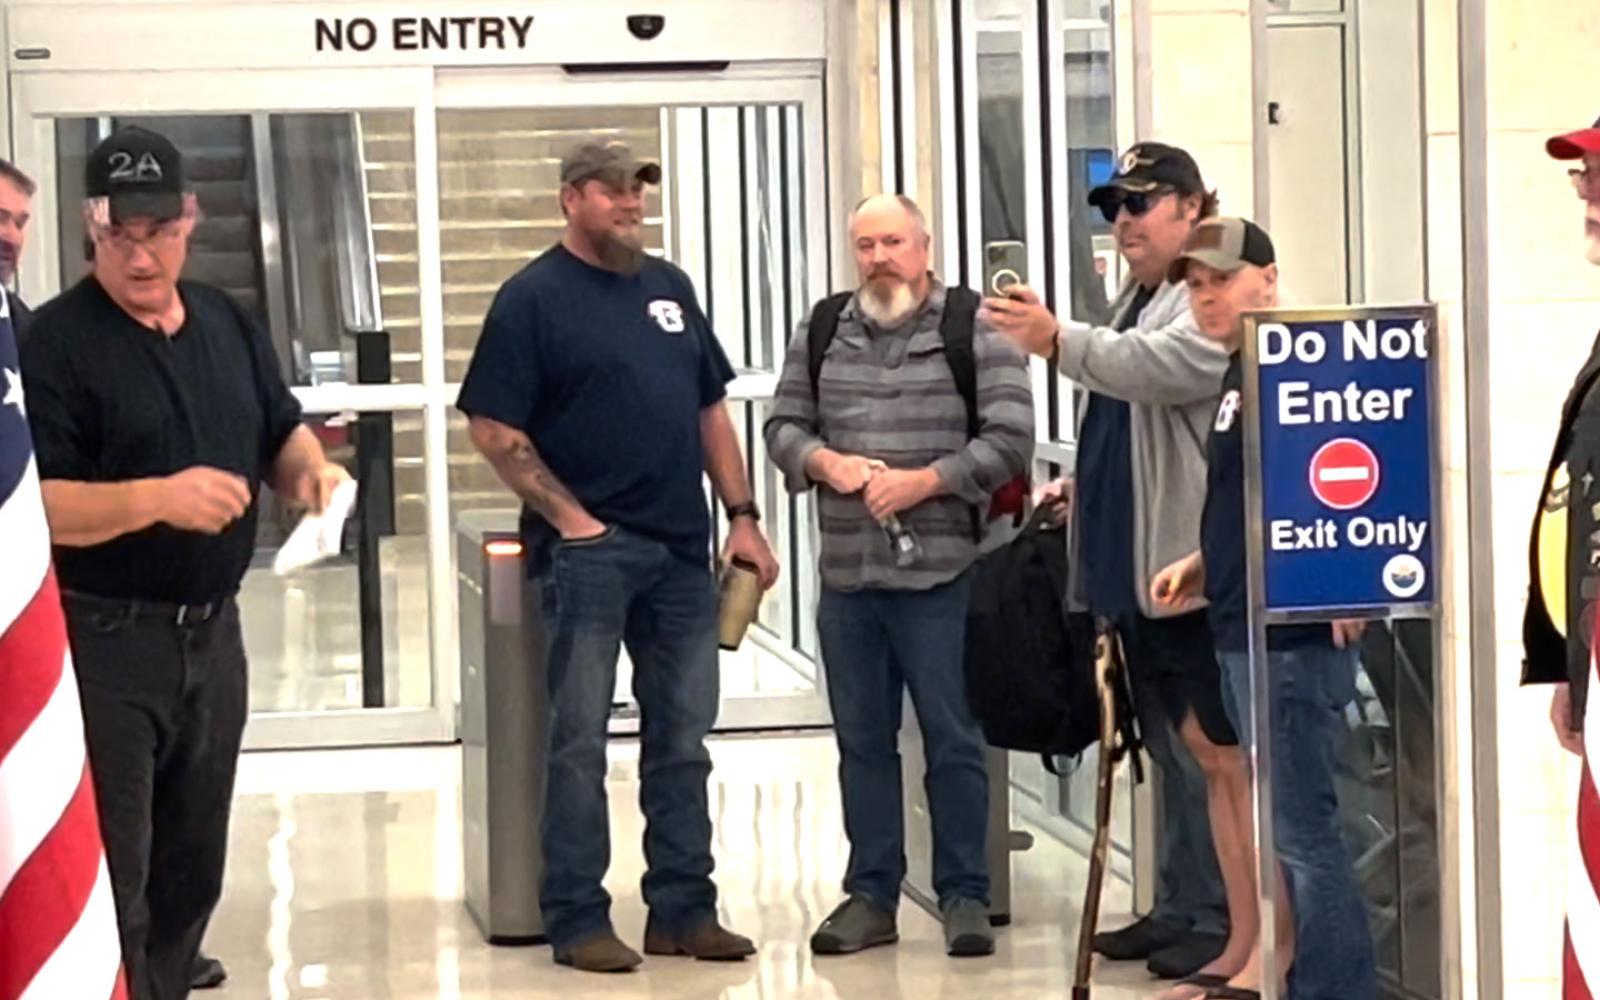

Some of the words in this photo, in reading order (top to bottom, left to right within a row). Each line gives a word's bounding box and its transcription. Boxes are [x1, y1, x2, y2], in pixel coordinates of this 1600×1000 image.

[315, 18, 377, 51] NO
[392, 16, 534, 50] ENTRY
[108, 151, 163, 181] 2A
[1258, 323, 1326, 364] Do
[1343, 320, 1428, 361] Not
[1278, 381, 1412, 424] Enter
[1270, 518, 1338, 550] Exit
[1347, 515, 1427, 551] Only
